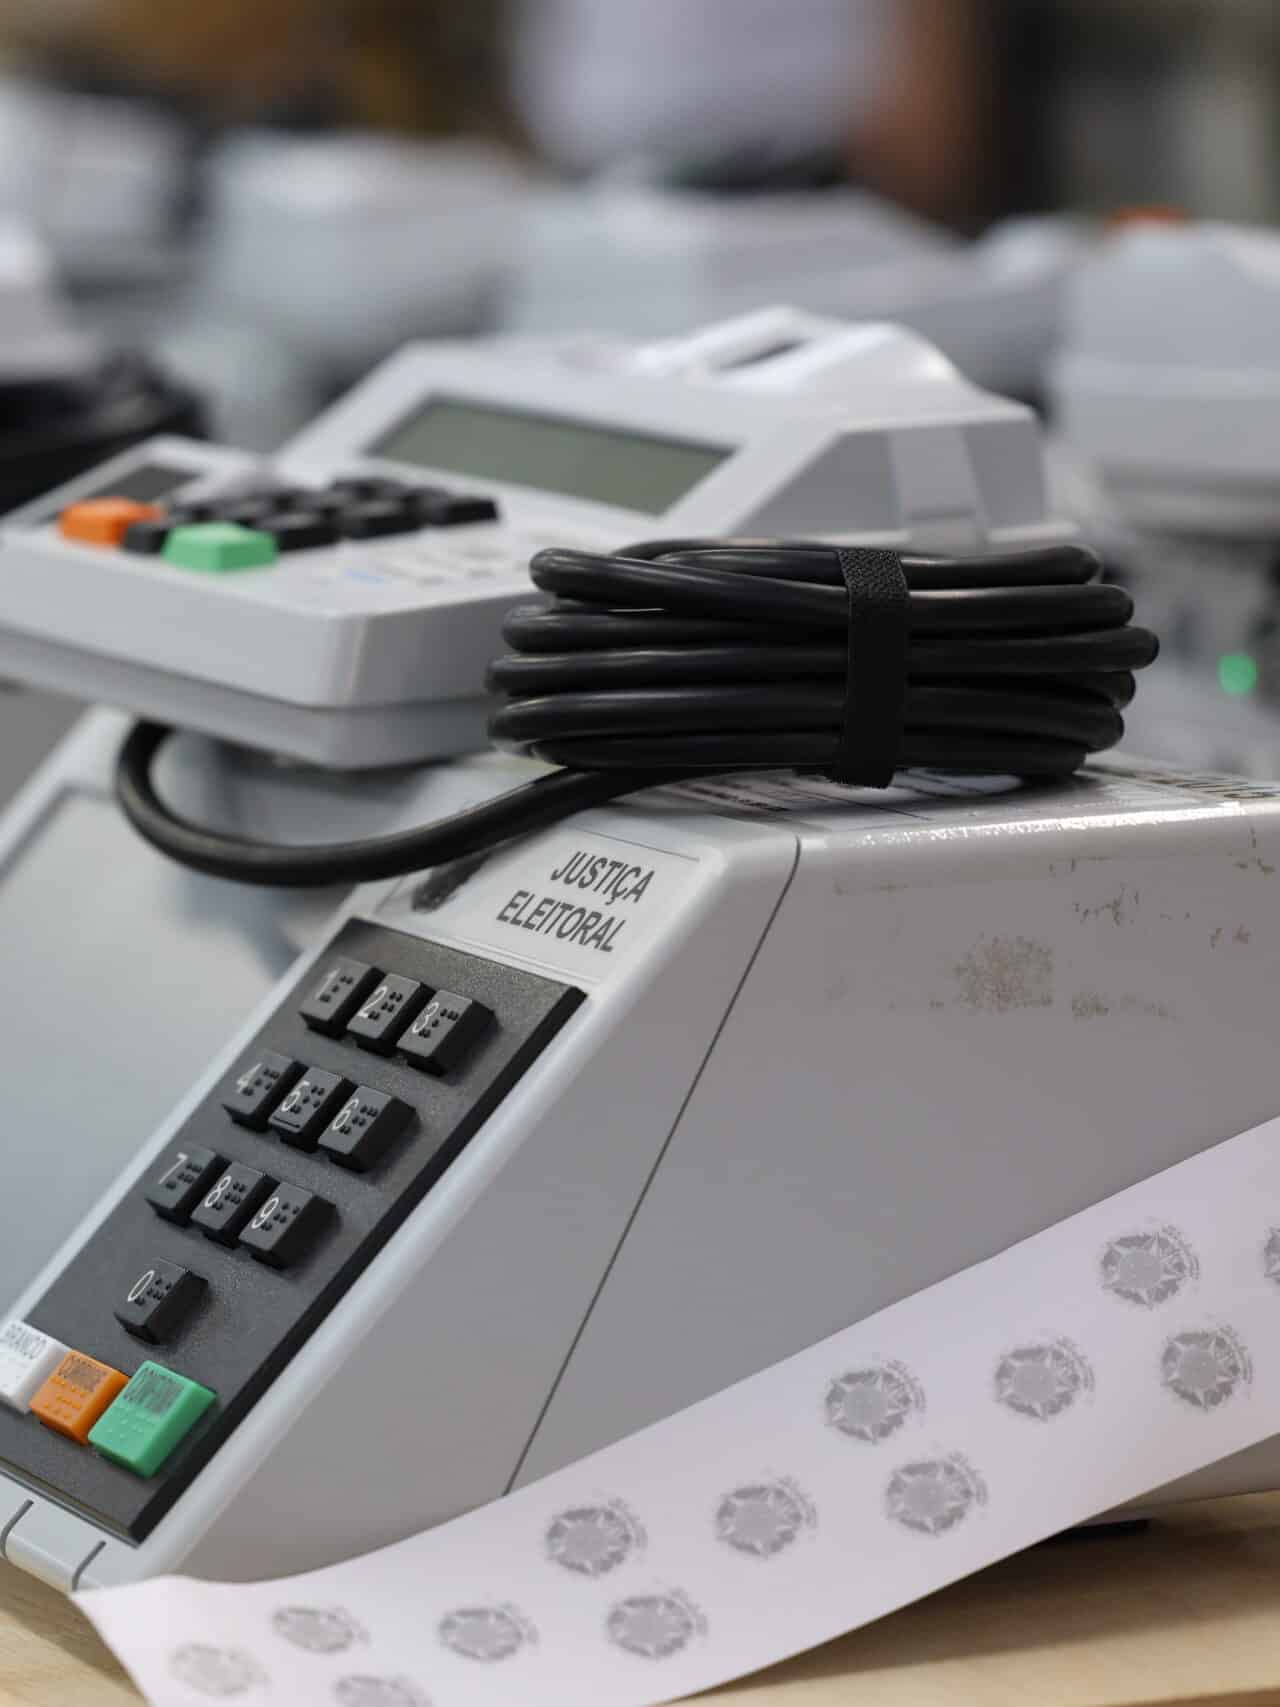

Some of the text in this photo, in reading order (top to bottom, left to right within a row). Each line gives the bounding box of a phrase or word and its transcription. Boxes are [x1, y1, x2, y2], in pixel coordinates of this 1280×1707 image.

[550, 851, 655, 905] JUSTIÇA
[496, 890, 626, 952] ELEITORAL
[357, 985, 389, 1019] 2
[412, 1002, 440, 1034] 3
[235, 1063, 263, 1094] 4
[281, 1080, 311, 1113] 5
[332, 1098, 359, 1131] 6
[157, 1152, 188, 1185] 7
[204, 1175, 232, 1208] 8
[251, 1197, 280, 1229] 9
